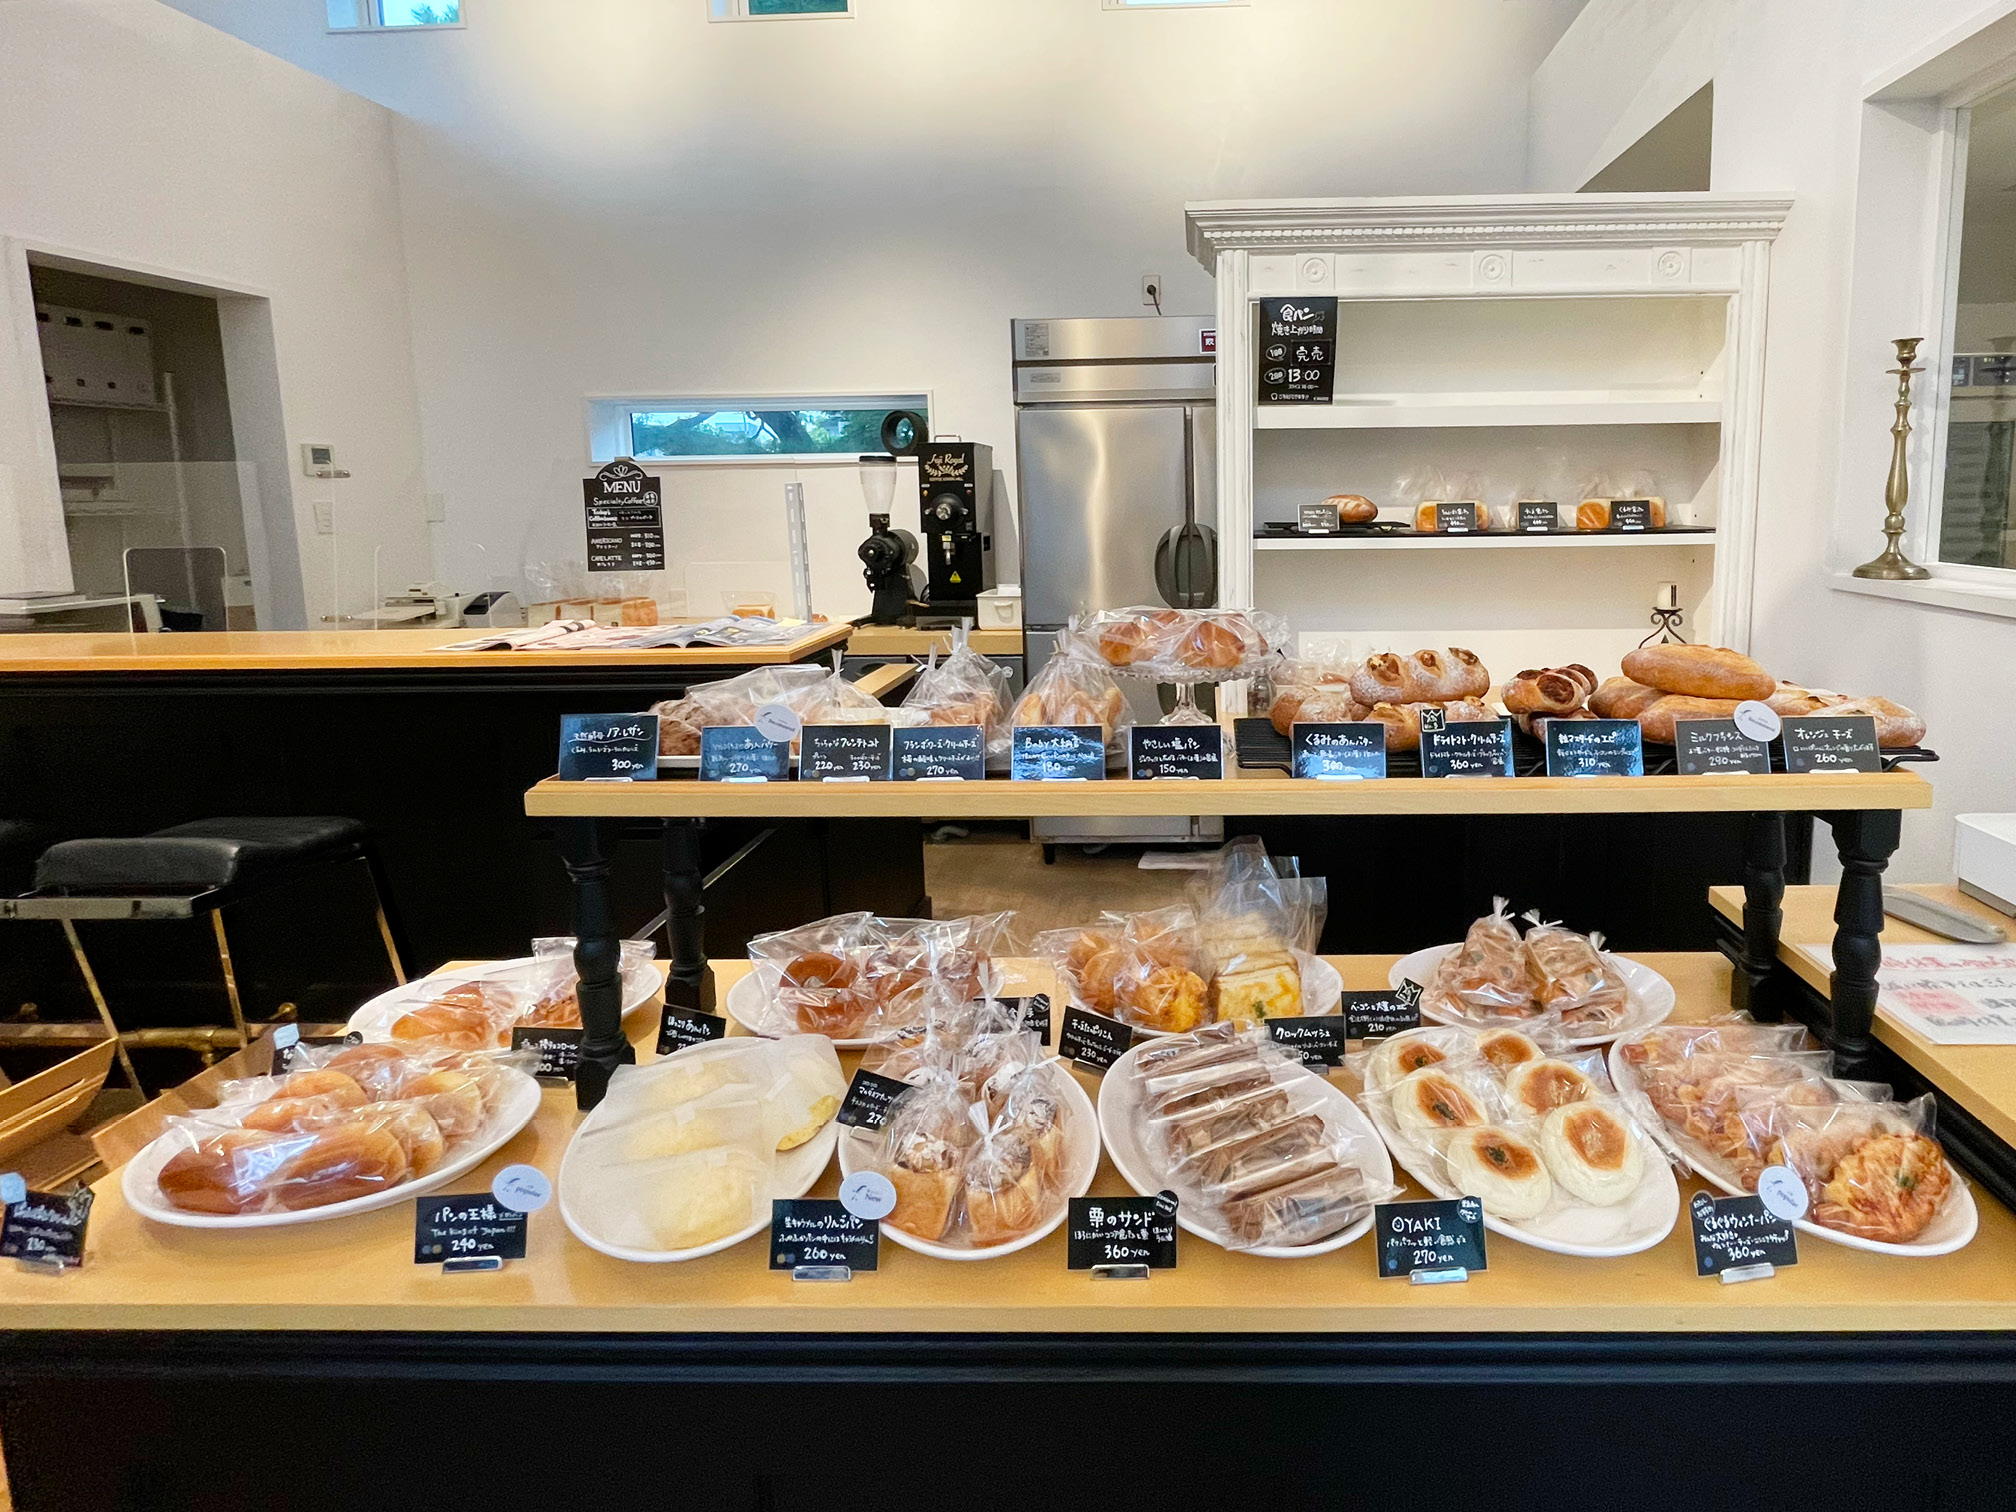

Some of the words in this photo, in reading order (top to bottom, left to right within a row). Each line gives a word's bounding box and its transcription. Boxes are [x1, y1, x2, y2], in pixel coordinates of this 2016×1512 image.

[1280, 304, 1314, 322] 食パン
[1296, 346, 1324, 361] 完売
[1288, 369, 1320, 382] 13:00
[945, 453, 964, 466] Royal
[603, 481, 640, 493] MENU
[1305, 733, 1373, 747] くるみのあんバター
[612, 759, 631, 770] 300
[1578, 758, 1595, 768] 310
[1814, 753, 1837, 763] 260
[729, 763, 749, 773] 270
[815, 761, 833, 770] 220
[852, 761, 870, 770] 230
[926, 765, 944, 776] 270
[1043, 762, 1060, 772] 180
[1160, 764, 1176, 774] 150
[1322, 759, 1343, 771] 300
[1450, 760, 1469, 770] 360
[1276, 1027, 1330, 1039] クロックムッシュ
[1368, 1023, 1384, 1032] 210
[1081, 1047, 1097, 1058] 230
[1096, 1055, 1108, 1064] yen
[435, 1204, 497, 1222] パンの王様
[1089, 1207, 1155, 1228] 栗のサンド
[1392, 1216, 1441, 1233] OYAKI
[452, 1238, 476, 1252] 240
[478, 1243, 494, 1252] yen
[803, 1247, 828, 1260] 260
[830, 1252, 846, 1261] yen
[1104, 1245, 1129, 1259] 360
[1131, 1249, 1150, 1258] yen
[1413, 1250, 1436, 1265] 270
[1438, 1254, 1454, 1263] yen
[1728, 1246, 1749, 1261] 360
[1750, 1249, 1766, 1258] yen
